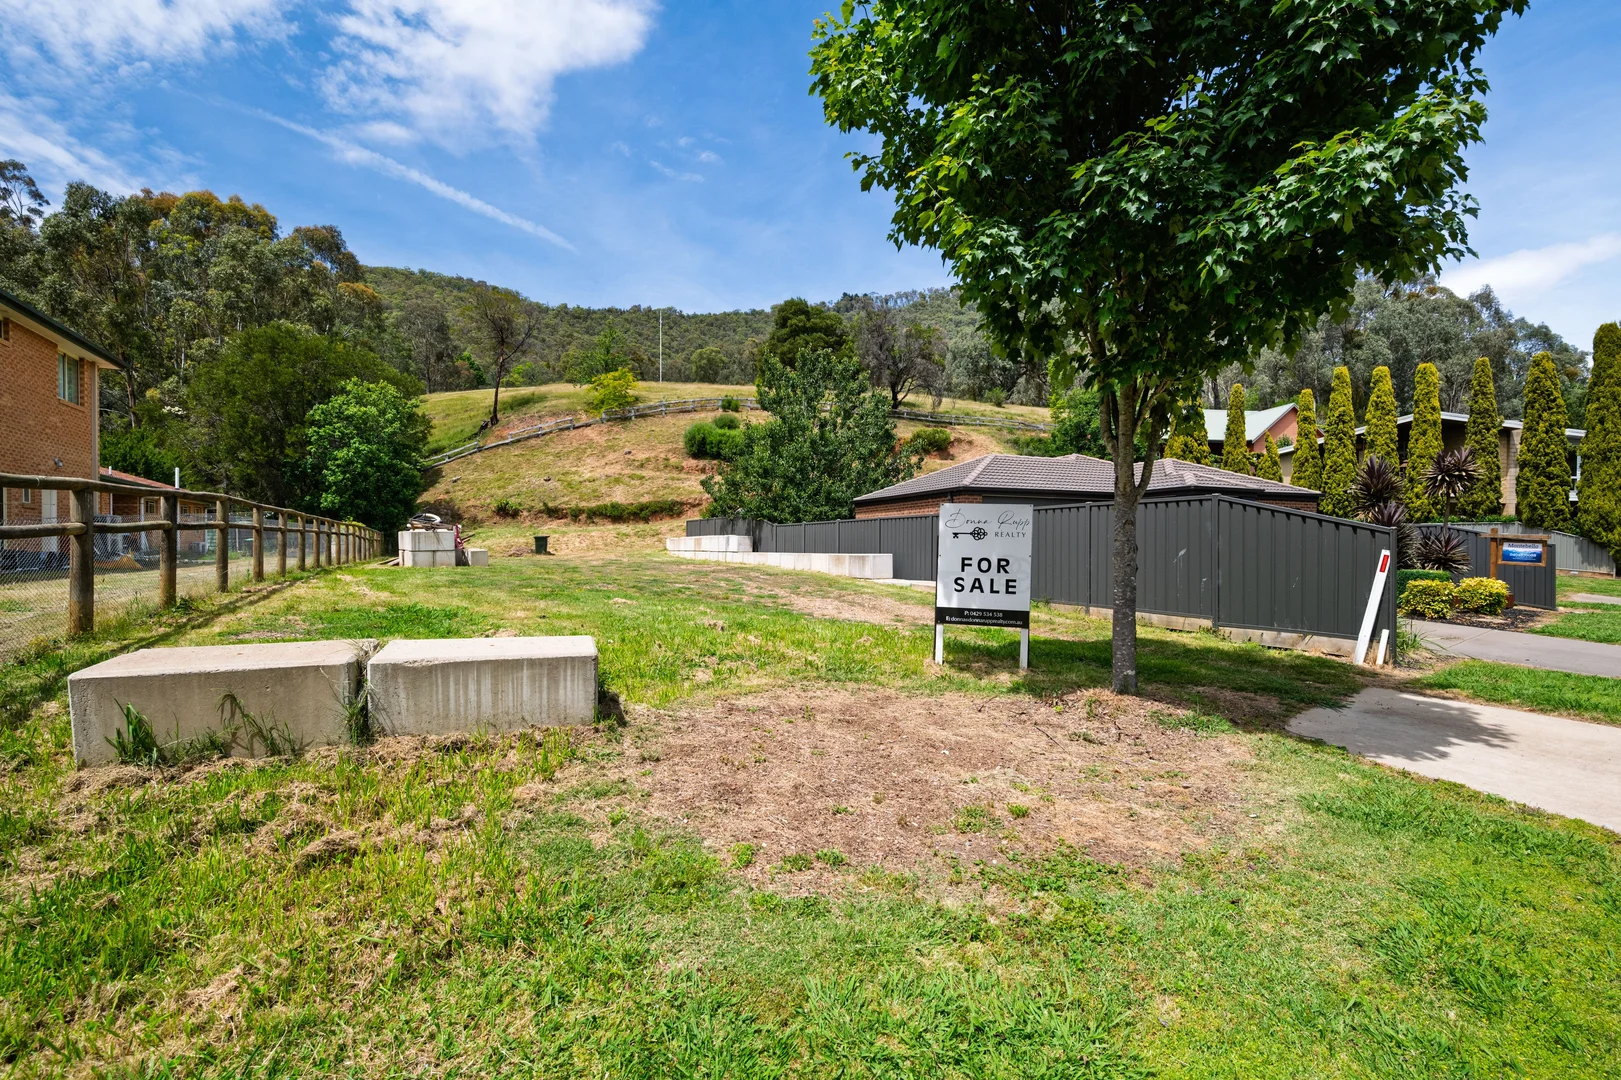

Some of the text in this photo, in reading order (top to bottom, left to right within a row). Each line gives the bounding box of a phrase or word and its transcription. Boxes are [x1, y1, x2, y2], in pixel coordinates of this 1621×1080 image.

[945, 508, 1030, 530] Donna Rupp
[961, 557, 1010, 574] FOR
[954, 577, 1016, 594] SALE
